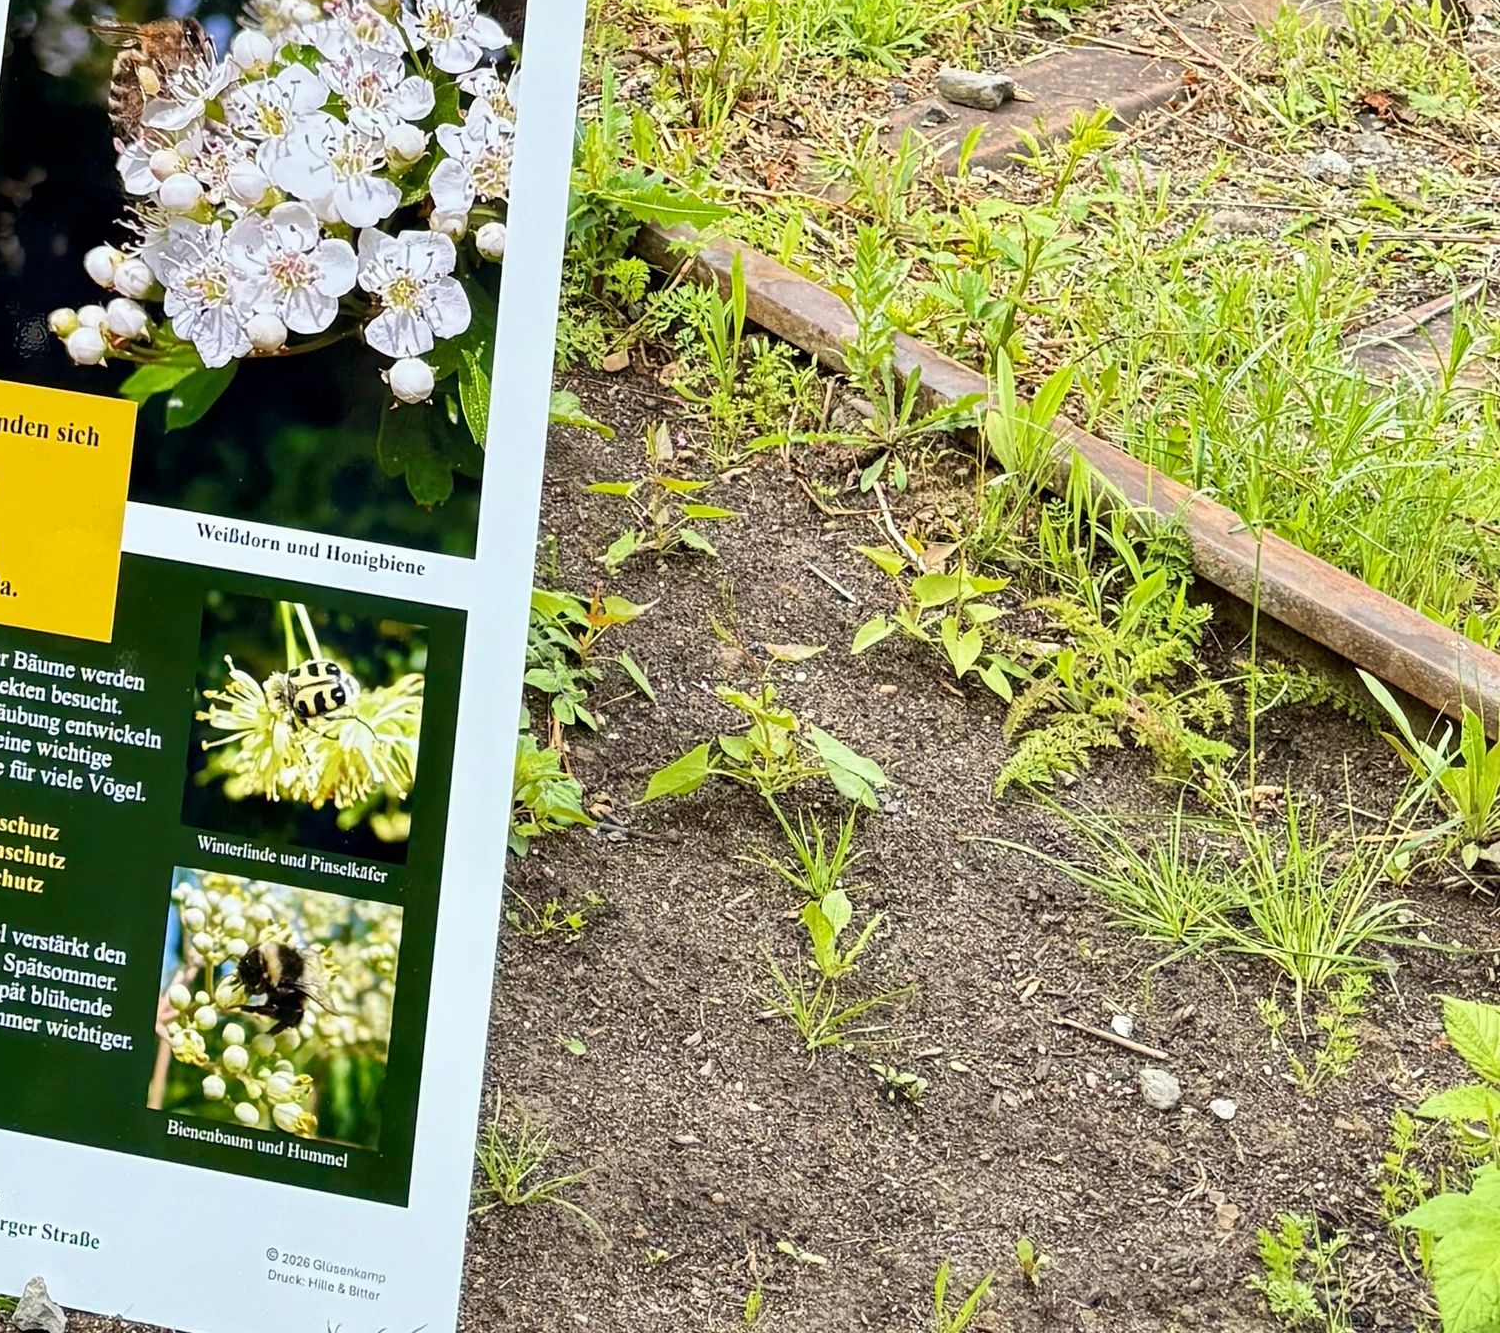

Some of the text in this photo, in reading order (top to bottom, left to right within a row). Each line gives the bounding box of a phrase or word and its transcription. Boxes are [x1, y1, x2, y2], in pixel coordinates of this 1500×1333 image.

[57, 422, 99, 447] sich
[197, 522, 425, 576] Weißdorn und Honigbiene
[13, 650, 76, 679] Bäume
[80, 666, 145, 692] werden
[51, 684, 123, 716] besucht.
[197, 834, 389, 884] Winterlinde und Pinselkäfer
[11, 930, 90, 958] verstärkt
[93, 942, 127, 966] den
[3, 952, 118, 992] Spätsommer.
[167, 1118, 348, 1168] Bienenbaum und Hummel
[41, 1223, 100, 1250] Straße
[281, 1252, 311, 1268] 2026
[267, 1268, 305, 1286] Druck:
[337, 1282, 346, 1294] &
